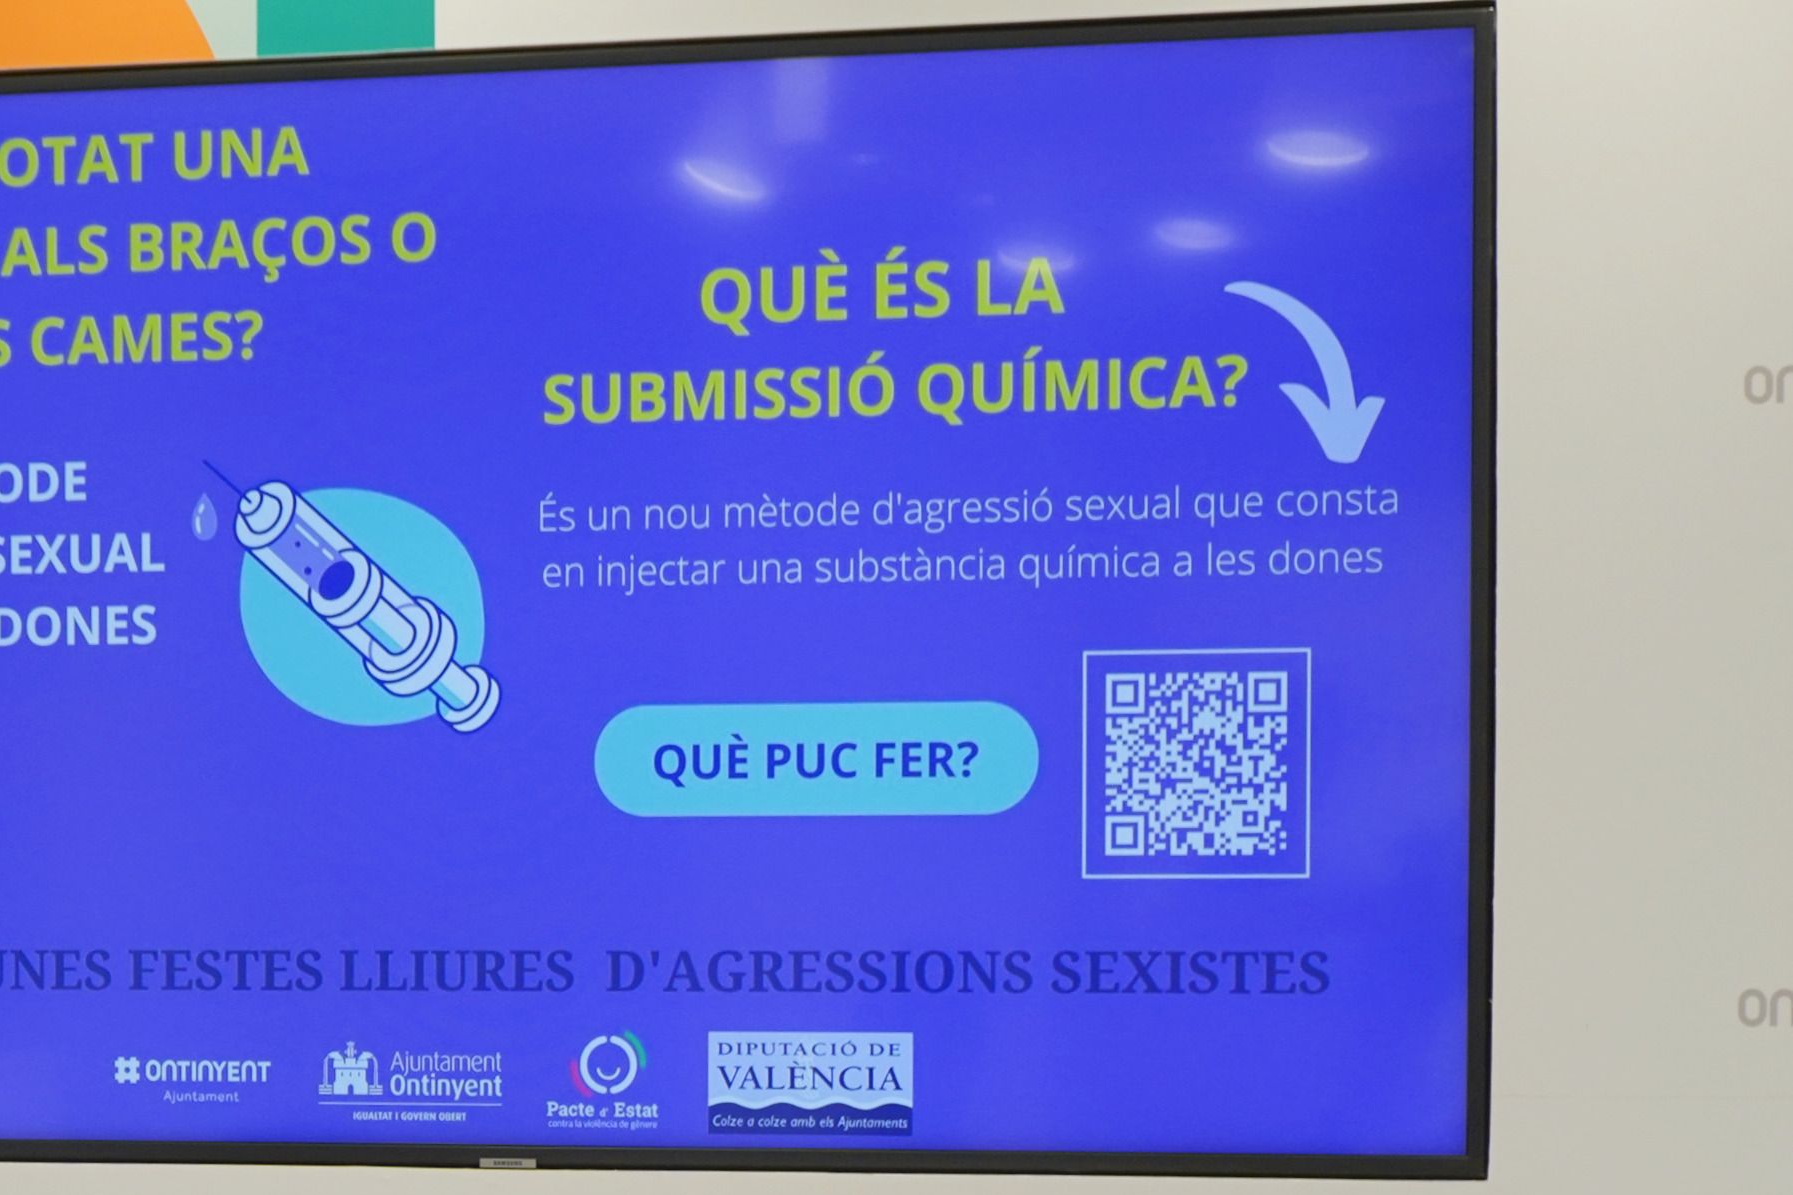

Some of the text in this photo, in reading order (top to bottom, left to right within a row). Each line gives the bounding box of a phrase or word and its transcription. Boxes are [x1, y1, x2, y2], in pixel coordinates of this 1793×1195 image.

[174, 126, 309, 180] UNA
[1, 224, 108, 276] ALS
[129, 214, 371, 283] BRAÇOS
[391, 212, 436, 262] O
[700, 246, 1064, 336] QUÈ ÉS LA
[31, 310, 263, 366] CAMES?
[543, 346, 1248, 425] SUBMISSIÓ QUÍMICA?
[540, 485, 1398, 533] És un nou mètode d'agressió sexual que consta
[543, 541, 1383, 596] en injectar una substància química a les dones
[654, 734, 978, 787] QUÈ PUC FER?
[129, 949, 322, 991] FESTES
[340, 950, 574, 992] LLIURES
[606, 950, 1032, 994] D'AGRESSIONS
[1051, 951, 1329, 995] SEXISTES
[719, 1041, 898, 1056] DIPUTACIÓ DE
[146, 1059, 271, 1082] ONTINYENT
[391, 1051, 501, 1077] Ajuntament
[718, 1061, 902, 1090] VALÈNCIA
[163, 1090, 239, 1104] Ajuntament
[391, 1074, 502, 1100] Ontinyent
[353, 1112, 392, 1120] IGUALTAT
[401, 1112, 436, 1120] GOVERN
[438, 1112, 466, 1121] OBERT
[547, 1101, 594, 1117] Pacte
[614, 1102, 658, 1118] Estat
[548, 1120, 573, 1128] contra
[575, 1120, 582, 1128] la
[619, 1120, 629, 1128] de
[713, 1114, 907, 1131] Colze a colze amb els Ajuntaments
